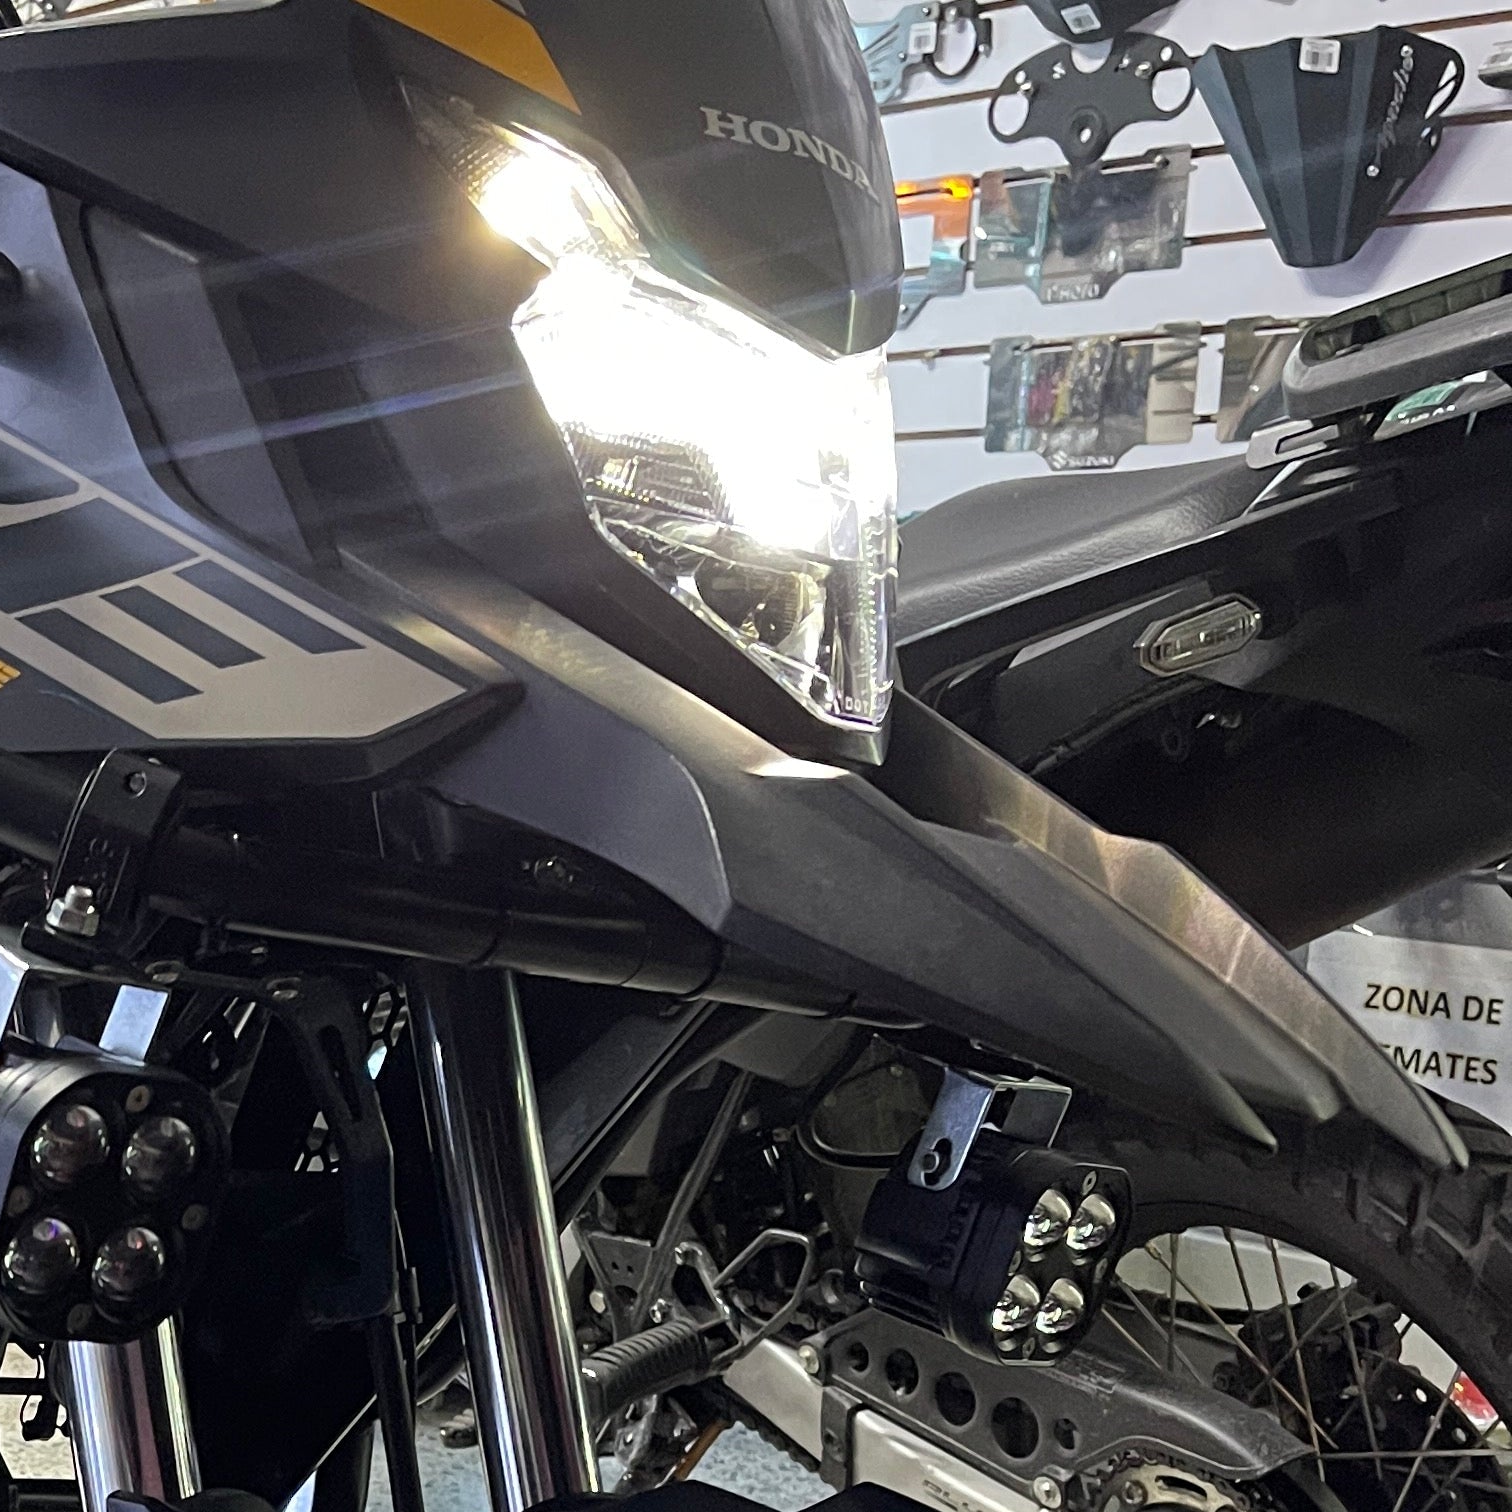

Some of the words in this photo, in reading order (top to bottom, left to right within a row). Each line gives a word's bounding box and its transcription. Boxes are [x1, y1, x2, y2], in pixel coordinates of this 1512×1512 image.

[698, 106, 880, 204] HONDA
[1364, 983, 1451, 1020] ZONA
[1462, 995, 1504, 1025] DE
[1381, 1044, 1498, 1086] MATES
